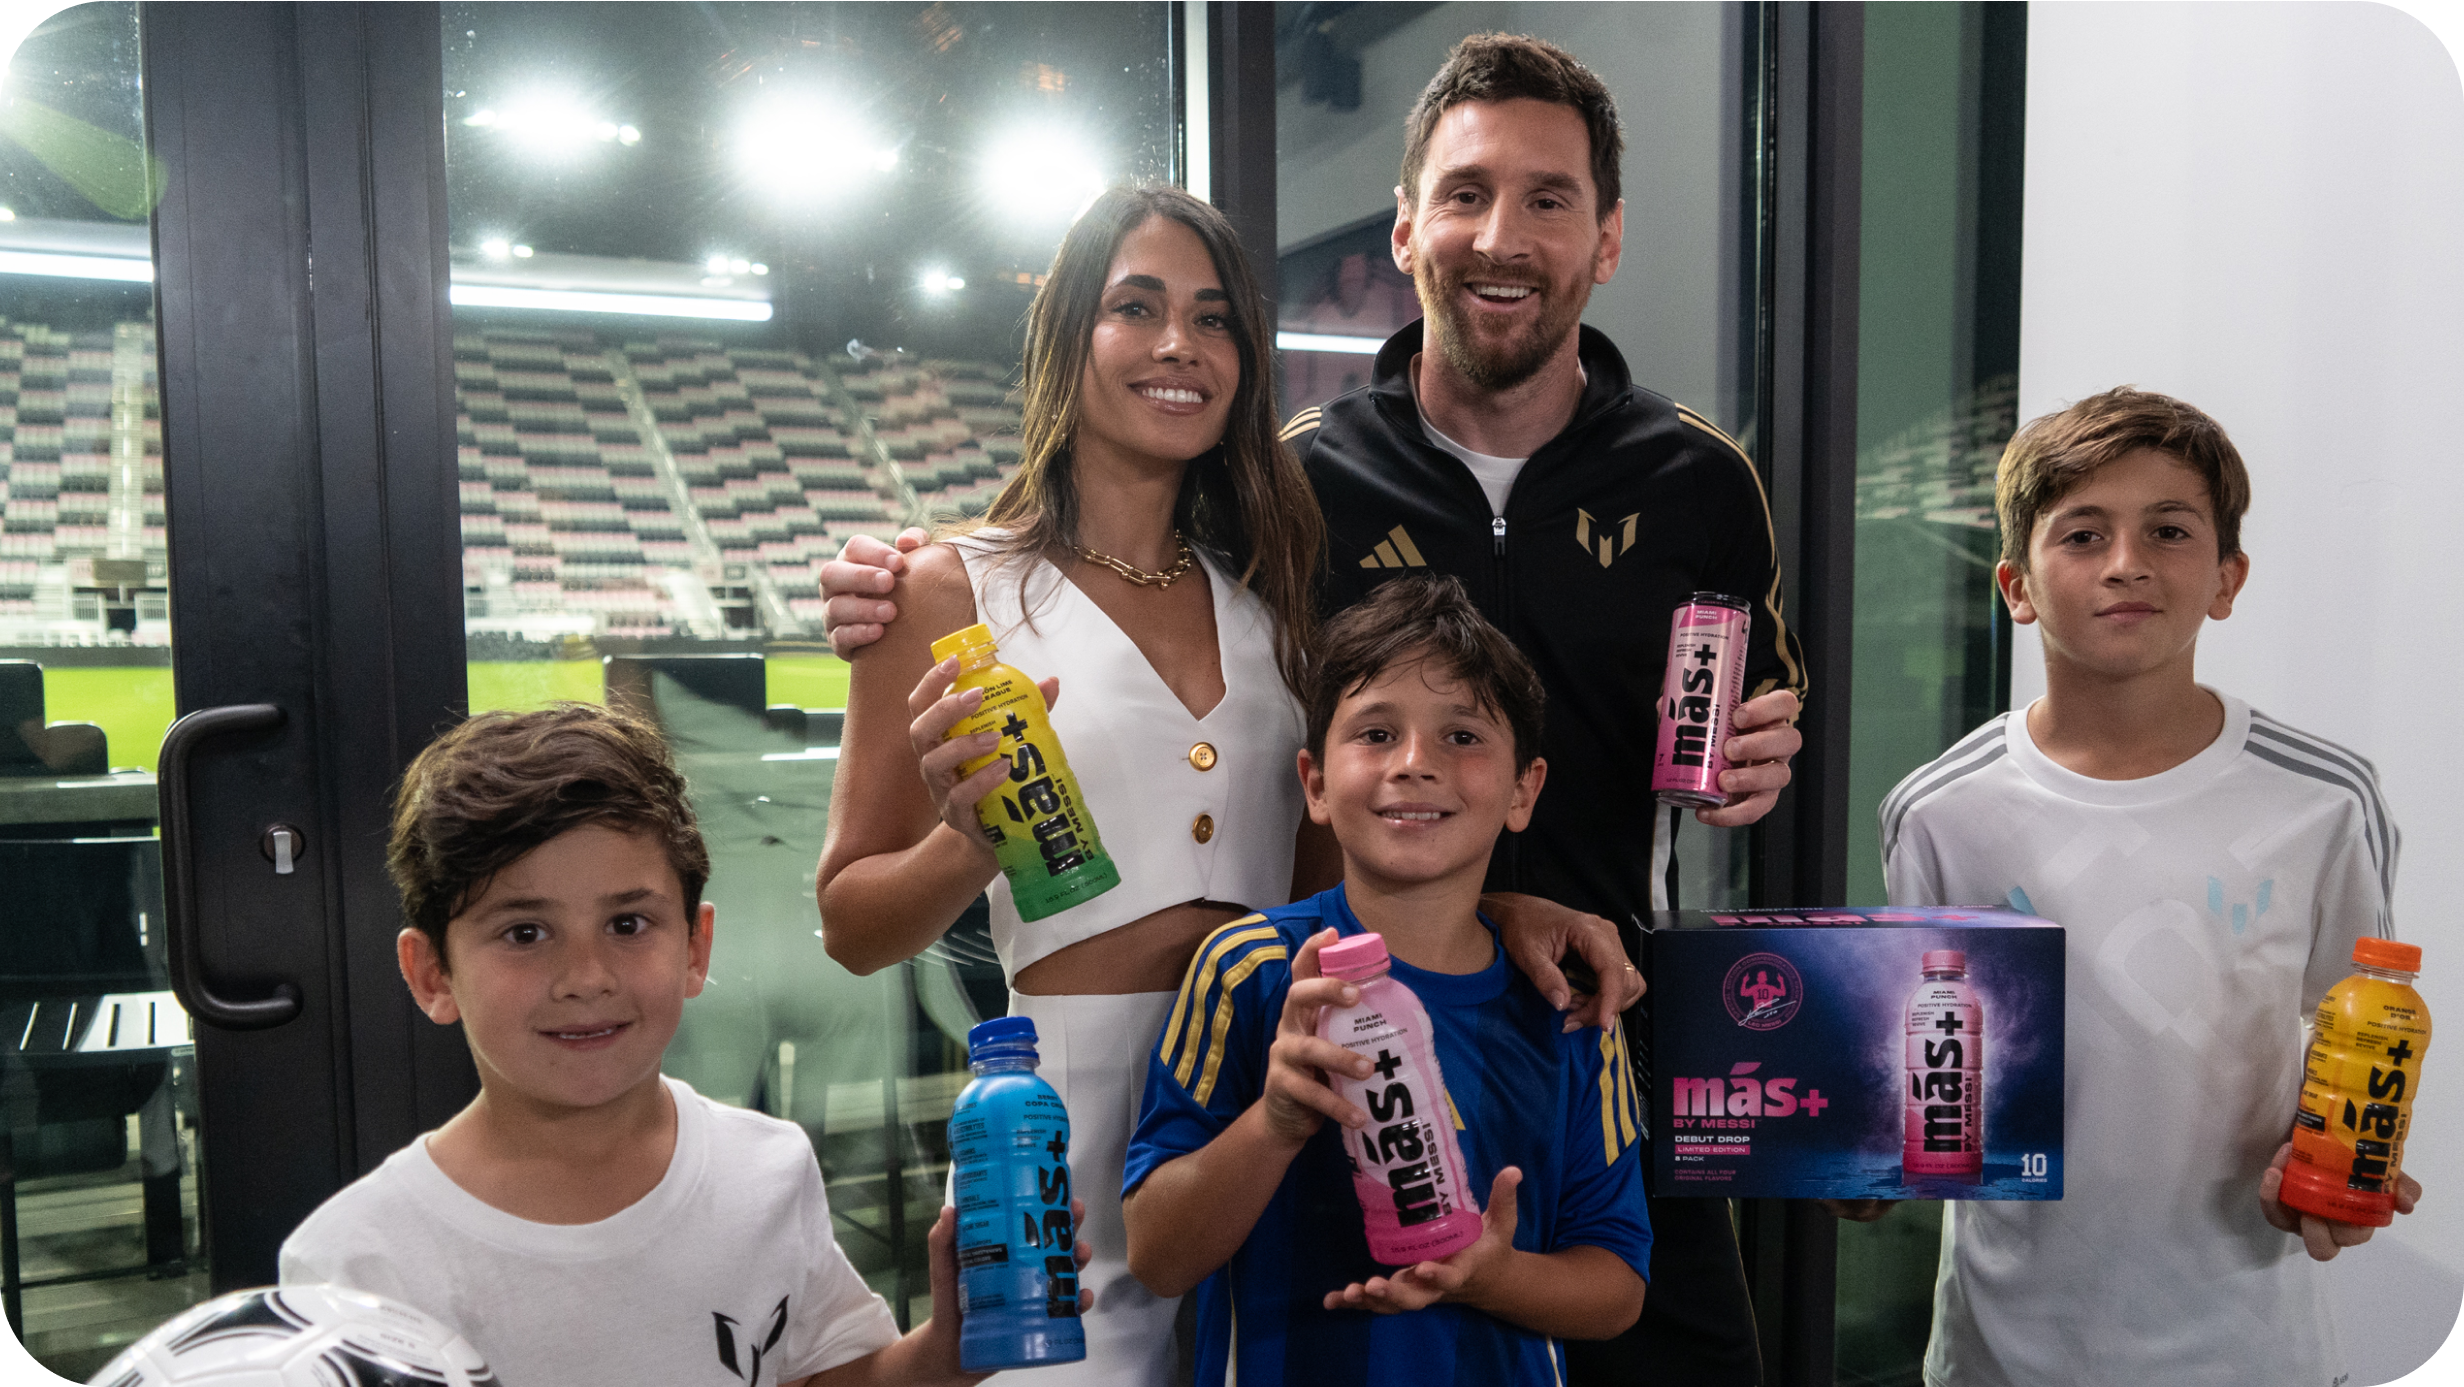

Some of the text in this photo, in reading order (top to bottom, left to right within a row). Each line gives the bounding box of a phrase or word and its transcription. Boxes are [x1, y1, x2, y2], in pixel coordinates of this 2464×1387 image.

[996, 679, 1013, 690] LIME
[970, 693, 1029, 721] POSITIVE HYDRATION
[1668, 643, 1718, 768] más+
[1707, 703, 1720, 770] BY MESSI
[1000, 712, 1087, 878] más+
[1055, 777, 1095, 861] BY MESSI
[1757, 988, 1769, 1000] 10
[1354, 1012, 1383, 1025] MIAMI
[2383, 1004, 2417, 1015] ORANGE
[2390, 1012, 2411, 1021] D'OR
[1353, 1019, 1387, 1033] PUNCH
[2357, 1031, 2389, 1041] REPLENISH
[2367, 1020, 2398, 1031] POSITIVE
[1341, 1027, 1408, 1049] POSITIVE HYDRATION
[2355, 1042, 2376, 1050] REVIVE
[2356, 1037, 2382, 1046] REFRESH
[1673, 1061, 1829, 1118] más+
[1912, 1011, 1964, 1153] más+
[1673, 1119, 1756, 1129] BY MESSI
[1964, 1077, 1973, 1153] BY MESSI
[2342, 1039, 2413, 1193] más+
[1361, 1048, 1442, 1228] más+
[1675, 1135, 1750, 1143] DEBUT DROP
[1422, 1122, 1453, 1217] BY MESSI
[2021, 1153, 2048, 1177] 10
[1024, 1130, 1079, 1318] más+
